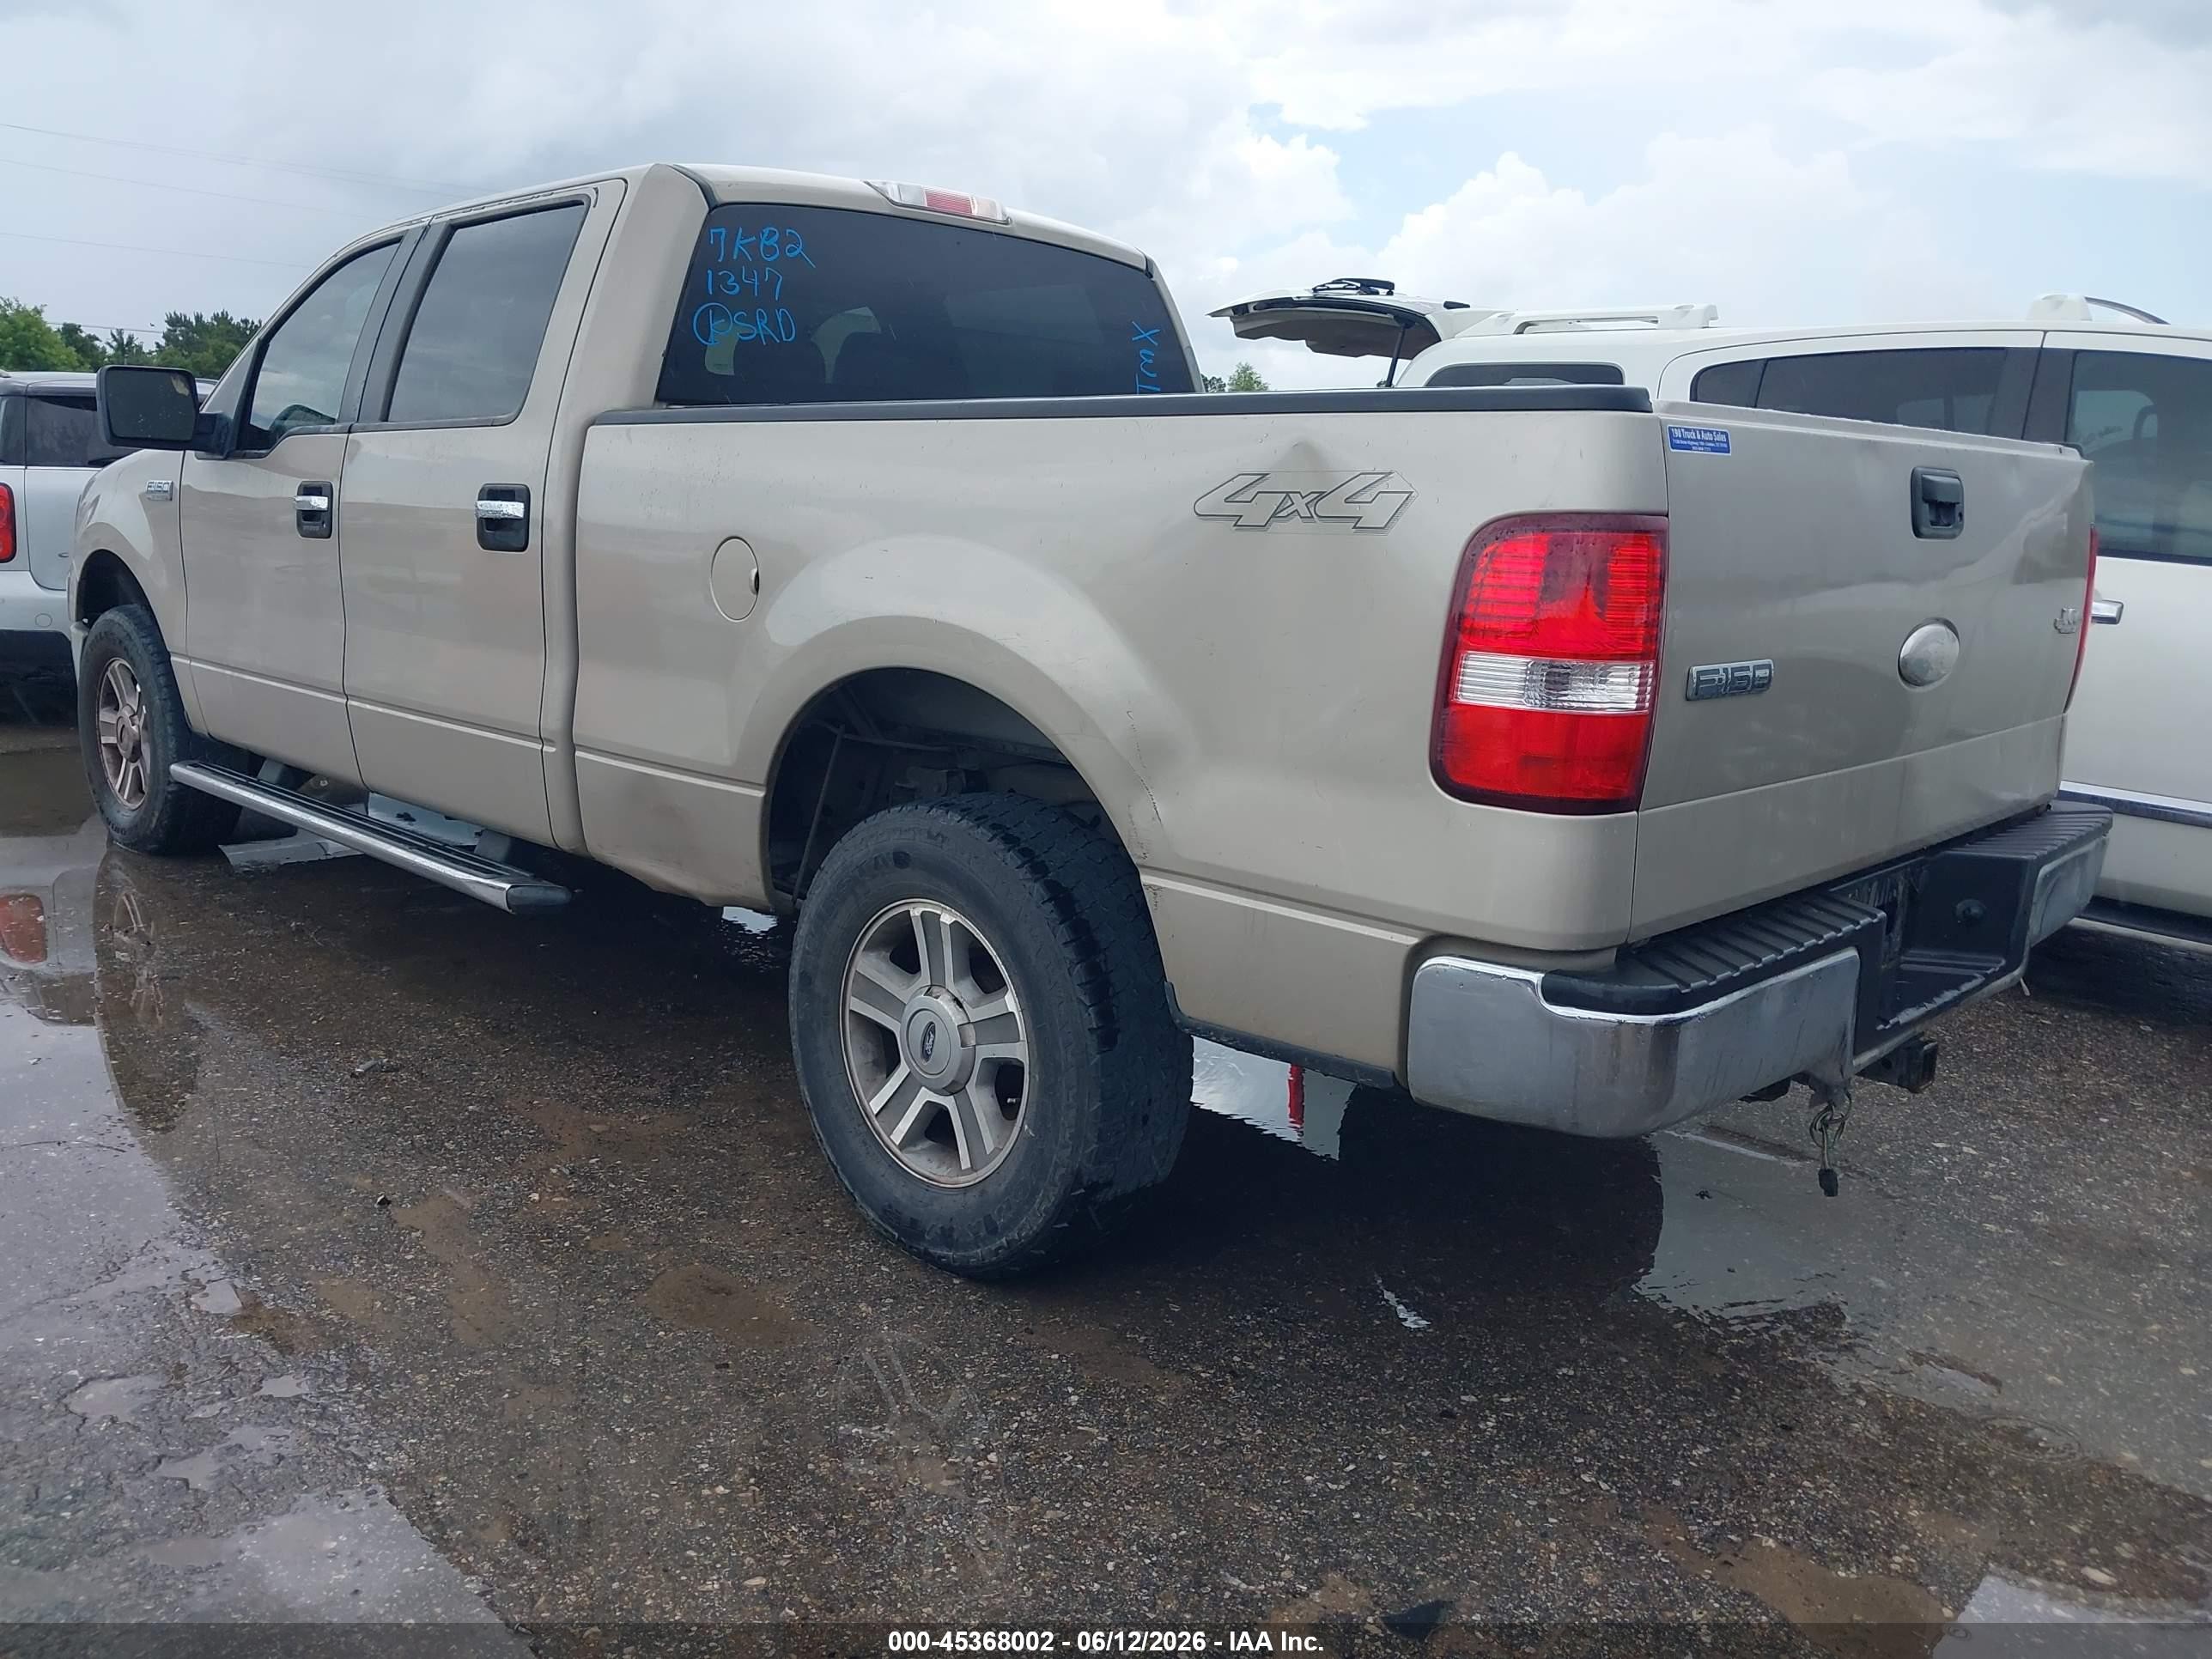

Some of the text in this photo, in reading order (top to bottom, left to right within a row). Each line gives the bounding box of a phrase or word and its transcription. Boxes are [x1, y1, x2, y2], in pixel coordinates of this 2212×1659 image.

[707, 265, 783, 301] 1347
[1681, 428, 1697, 441] Truck
[1701, 431, 1714, 441] Auto
[1713, 432, 1728, 442] Sales
[1194, 471, 1417, 533] 4x4
